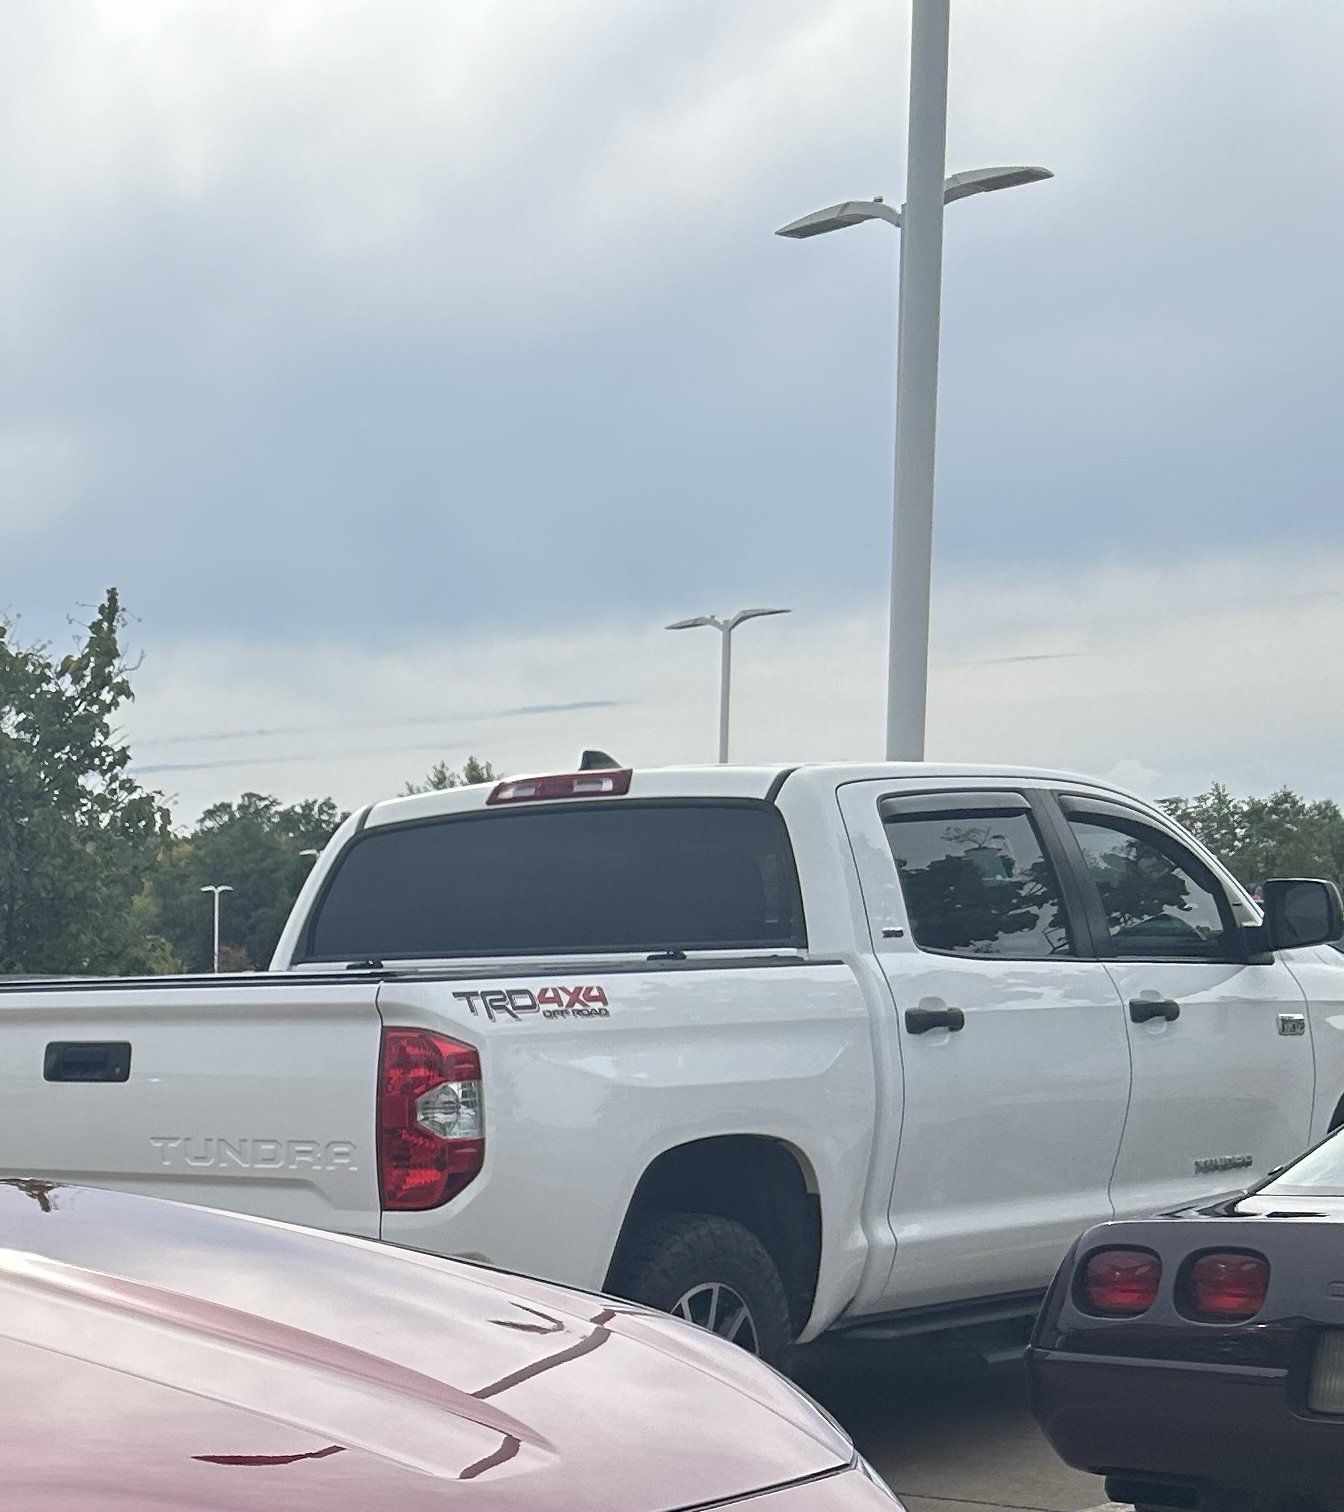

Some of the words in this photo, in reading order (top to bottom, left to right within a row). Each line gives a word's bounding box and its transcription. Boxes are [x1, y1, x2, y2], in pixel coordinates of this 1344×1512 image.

[452, 988, 540, 1022] TRD
[542, 1008, 571, 1020] OFF
[572, 1007, 611, 1019] ROAD
[149, 1136, 359, 1171] TUNDRA
